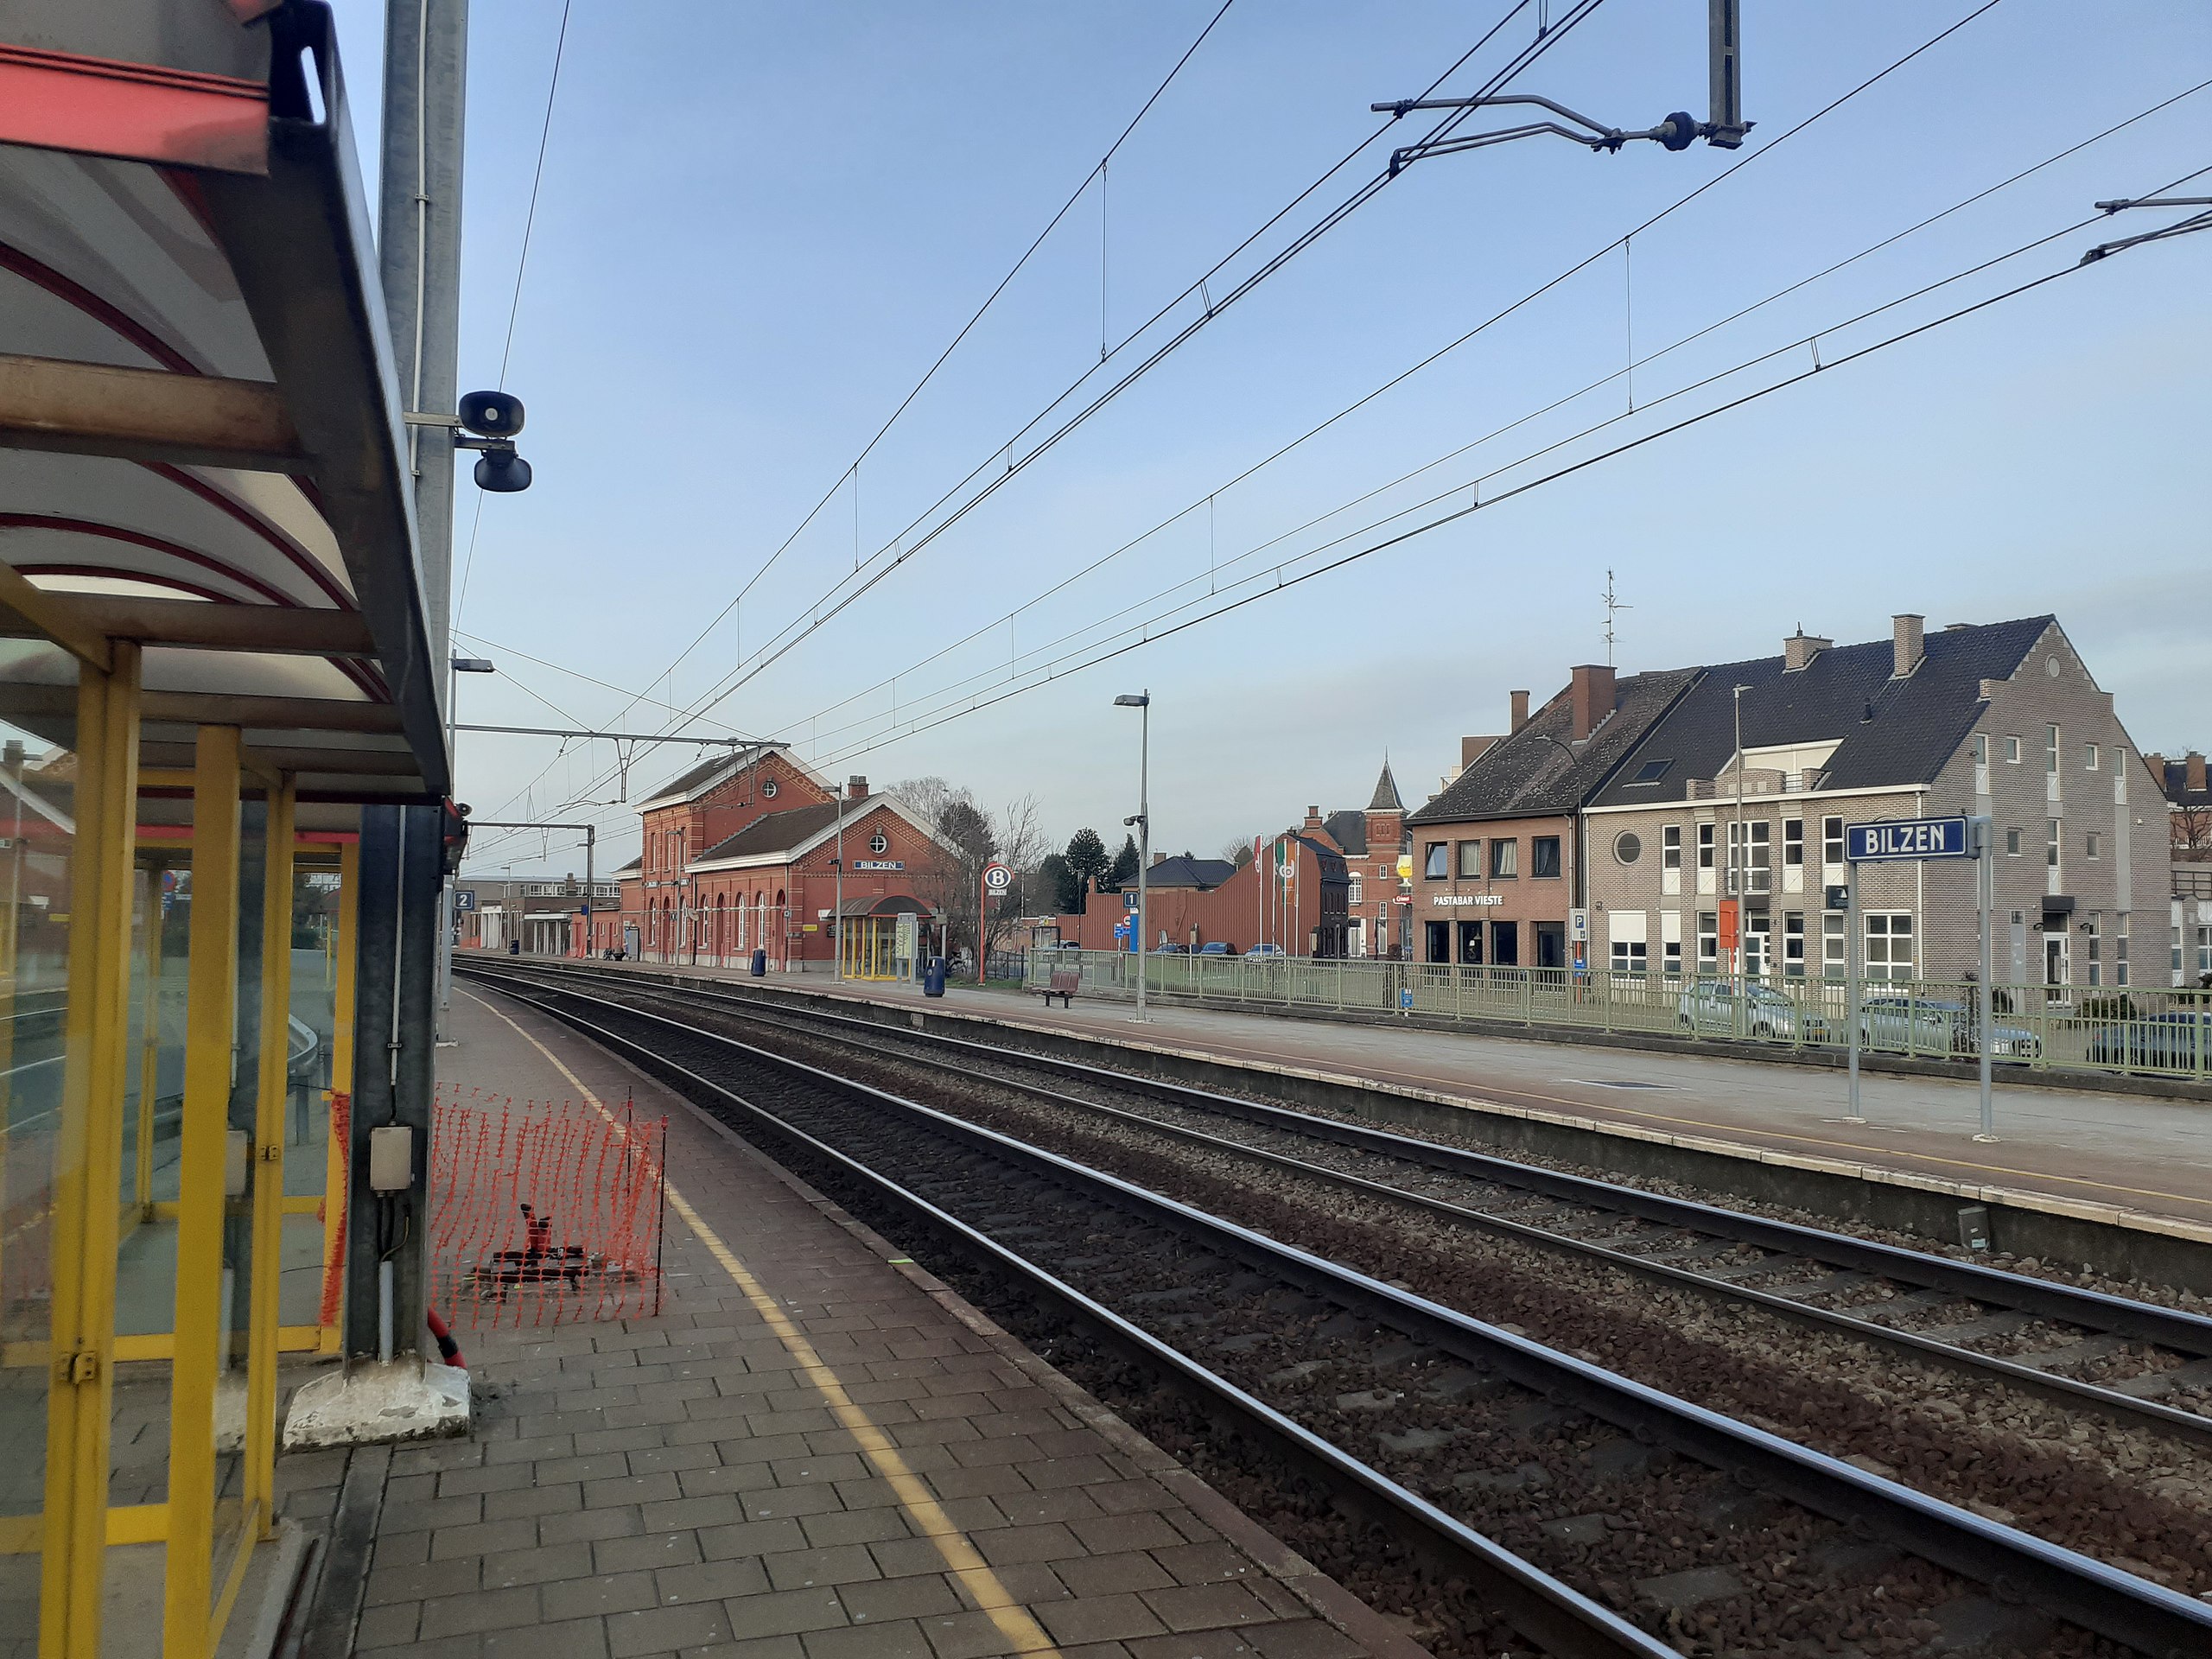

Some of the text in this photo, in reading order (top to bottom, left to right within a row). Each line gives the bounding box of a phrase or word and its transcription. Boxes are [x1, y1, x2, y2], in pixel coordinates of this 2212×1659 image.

[1866, 824, 1945, 854] BILZEN
[991, 870, 1005, 886] B
[459, 893, 468, 906] 2
[1129, 893, 1134, 905] 1
[1433, 895, 1503, 906] PASTABAR VIESTE
[1576, 916, 1583, 927] P
